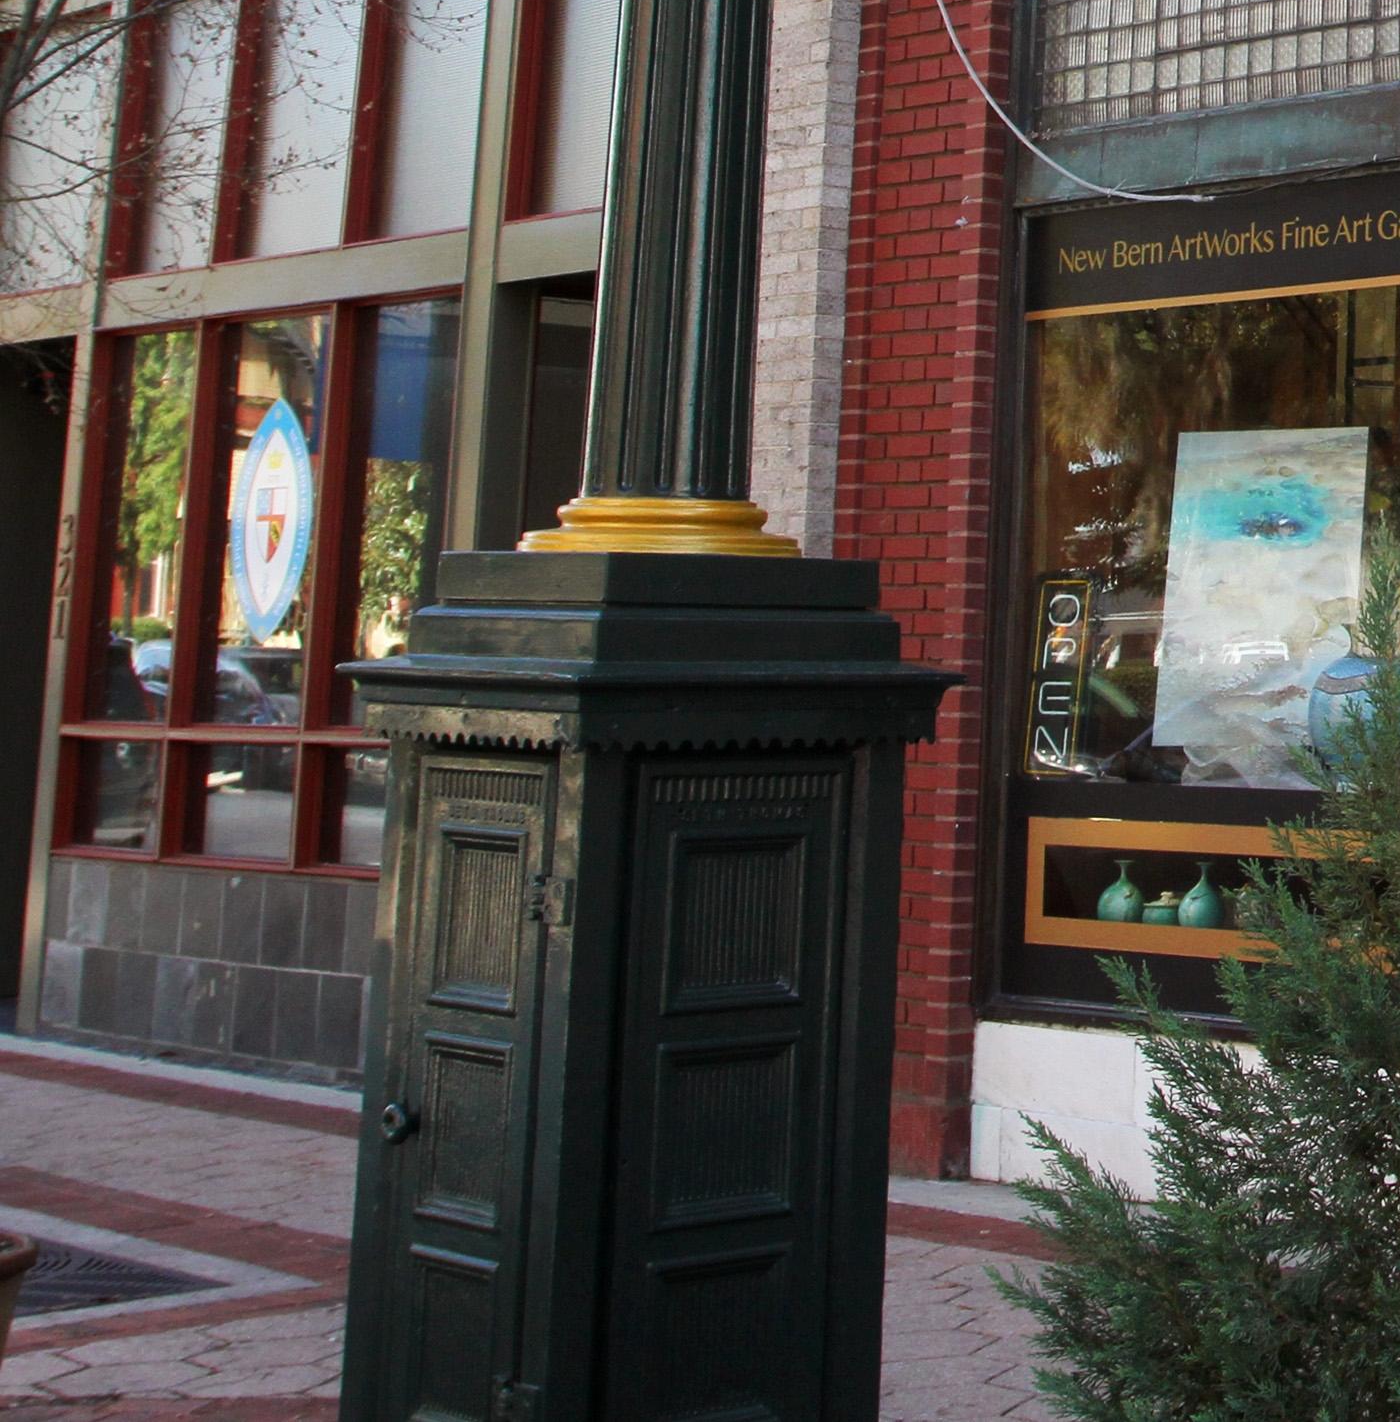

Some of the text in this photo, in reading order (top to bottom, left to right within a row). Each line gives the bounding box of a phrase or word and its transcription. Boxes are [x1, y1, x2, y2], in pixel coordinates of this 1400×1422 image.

[1058, 247, 1107, 275] New
[1112, 239, 1164, 269] Bern
[1168, 221, 1275, 260] ArtWorks
[1281, 216, 1330, 251] Fine
[1334, 215, 1374, 244] Art
[53, 513, 74, 640] 321
[1034, 594, 1081, 759] OPEN
